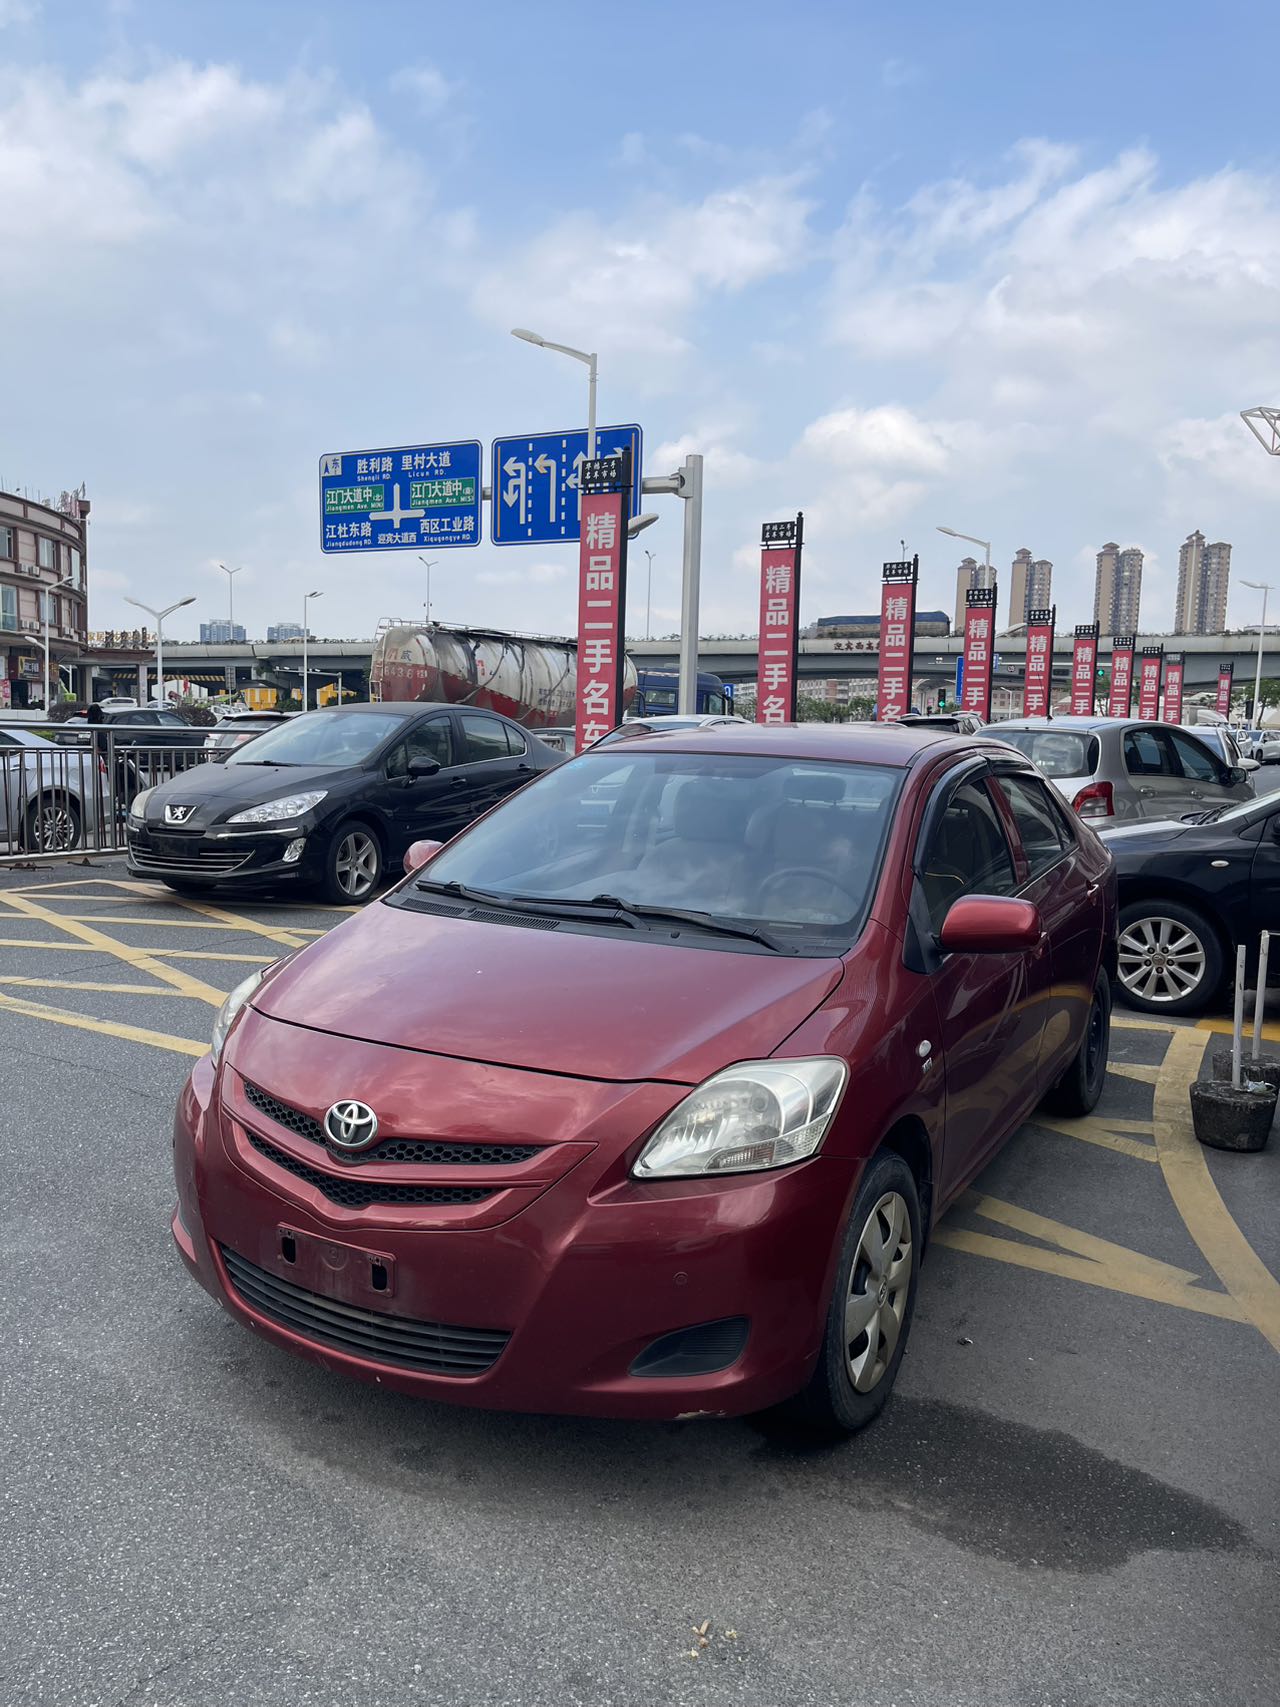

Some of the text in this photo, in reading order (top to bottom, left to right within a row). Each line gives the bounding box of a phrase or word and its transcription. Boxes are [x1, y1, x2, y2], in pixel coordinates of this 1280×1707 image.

[357, 450, 451, 474] 胜利路 里村大道
[408, 470, 430, 478] Licun
[357, 474, 380, 482] Shengli
[326, 504, 355, 512] Jiangmen
[412, 498, 443, 506] Jiangmen
[326, 521, 372, 539] 江杜东路
[420, 515, 475, 534] 西区工业路
[377, 532, 417, 544] 迎宾大道西
[762, 565, 791, 723] 精品二手名
[881, 597, 908, 723] 精品二手名
[965, 618, 989, 716] 精品二手
[1026, 635, 1048, 718] 精品二手
[1073, 647, 1093, 715] 精品二手
[1111, 656, 1129, 717] 精品二手
[1141, 665, 1158, 720] 精品二手
